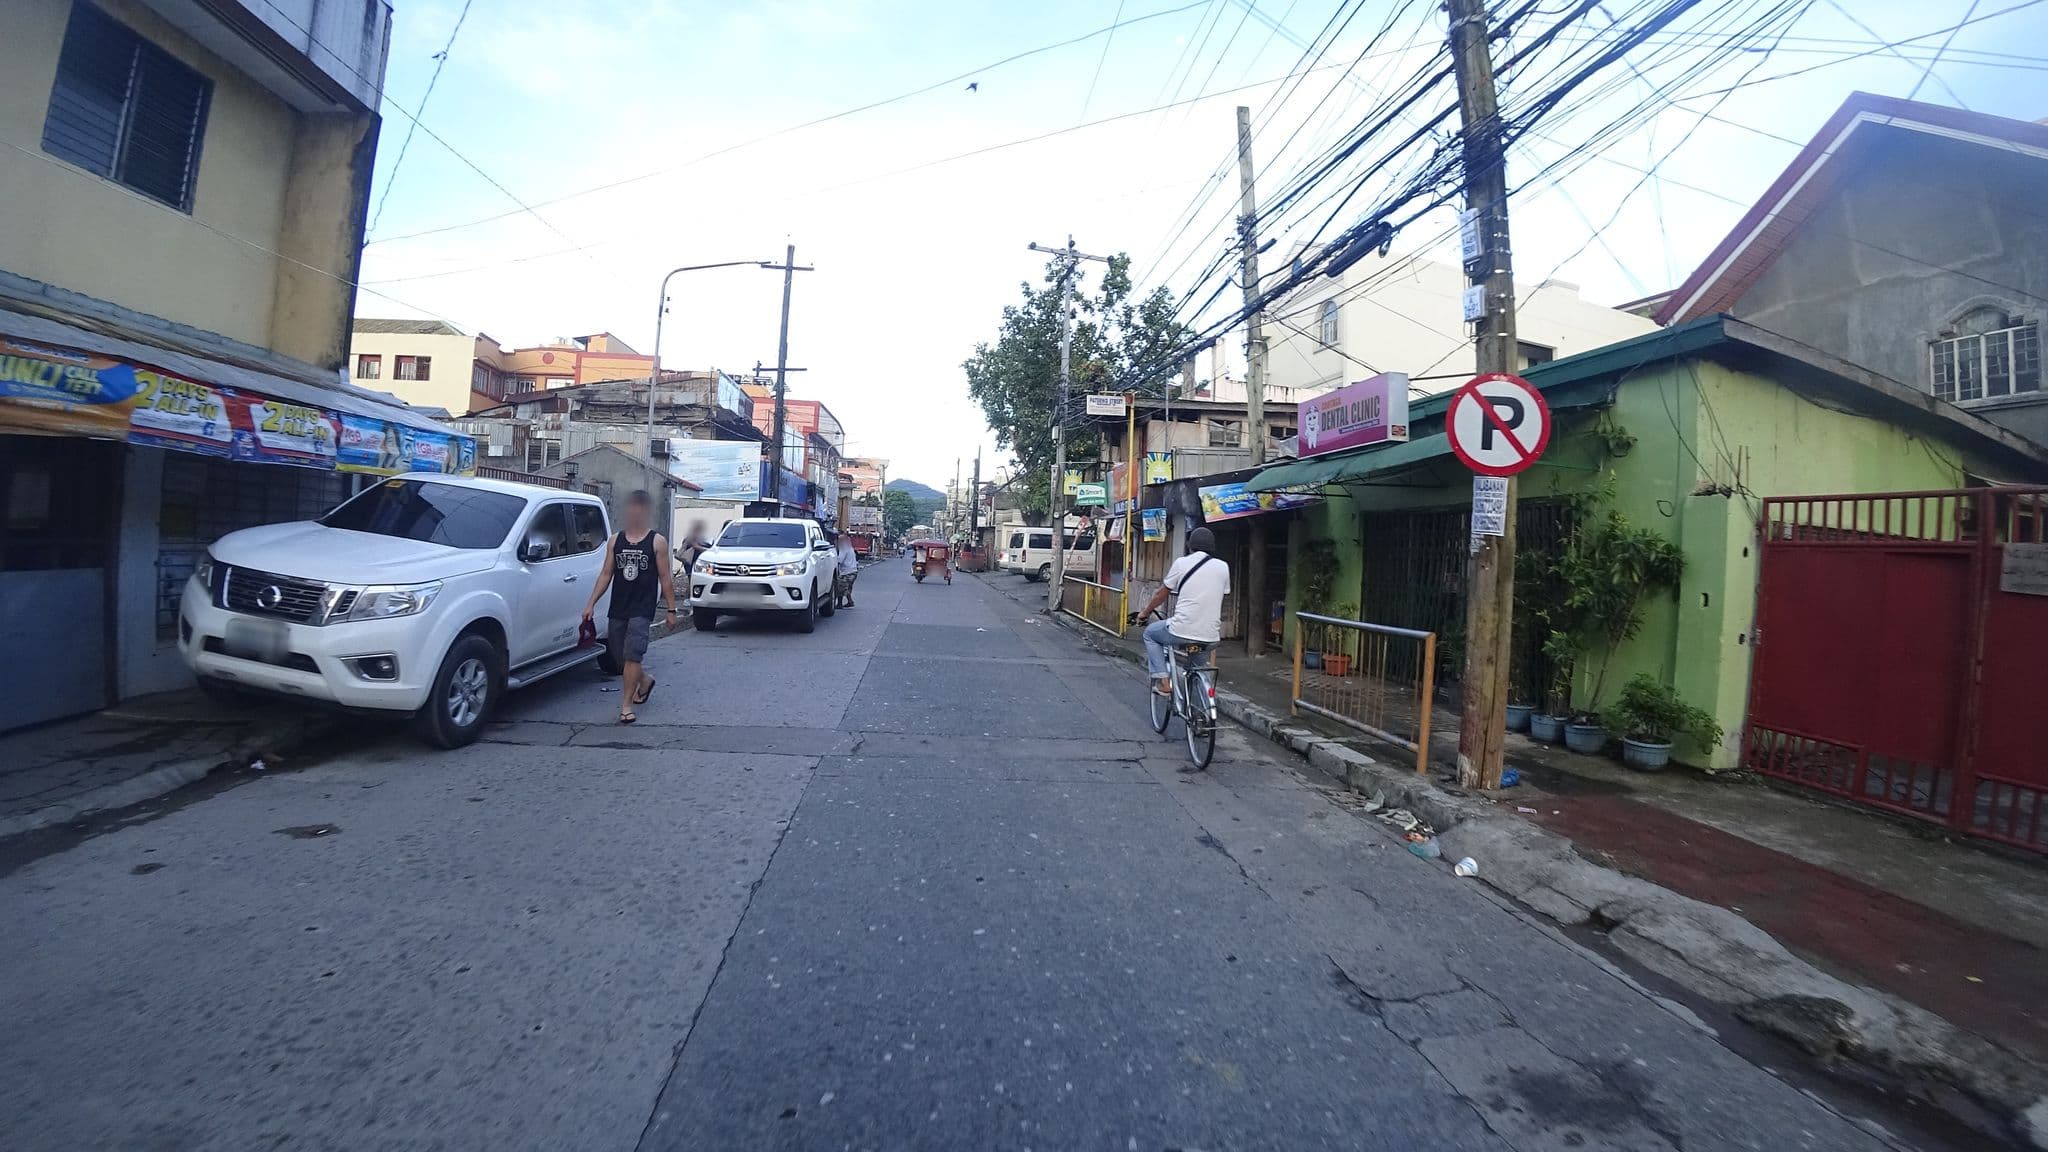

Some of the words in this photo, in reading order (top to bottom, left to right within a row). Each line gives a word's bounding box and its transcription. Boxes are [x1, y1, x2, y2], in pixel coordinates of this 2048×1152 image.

[134, 370, 157, 409] 2
[162, 377, 208, 402] DAYS
[154, 394, 218, 421] ALL-IN
[262, 401, 283, 432] 2
[284, 405, 319, 425] DAYS
[1321, 405, 1349, 432] DENTAL
[1351, 395, 1380, 424] CLINIC
[1481, 395, 1525, 451] P
[616, 552, 649, 570] NETS
